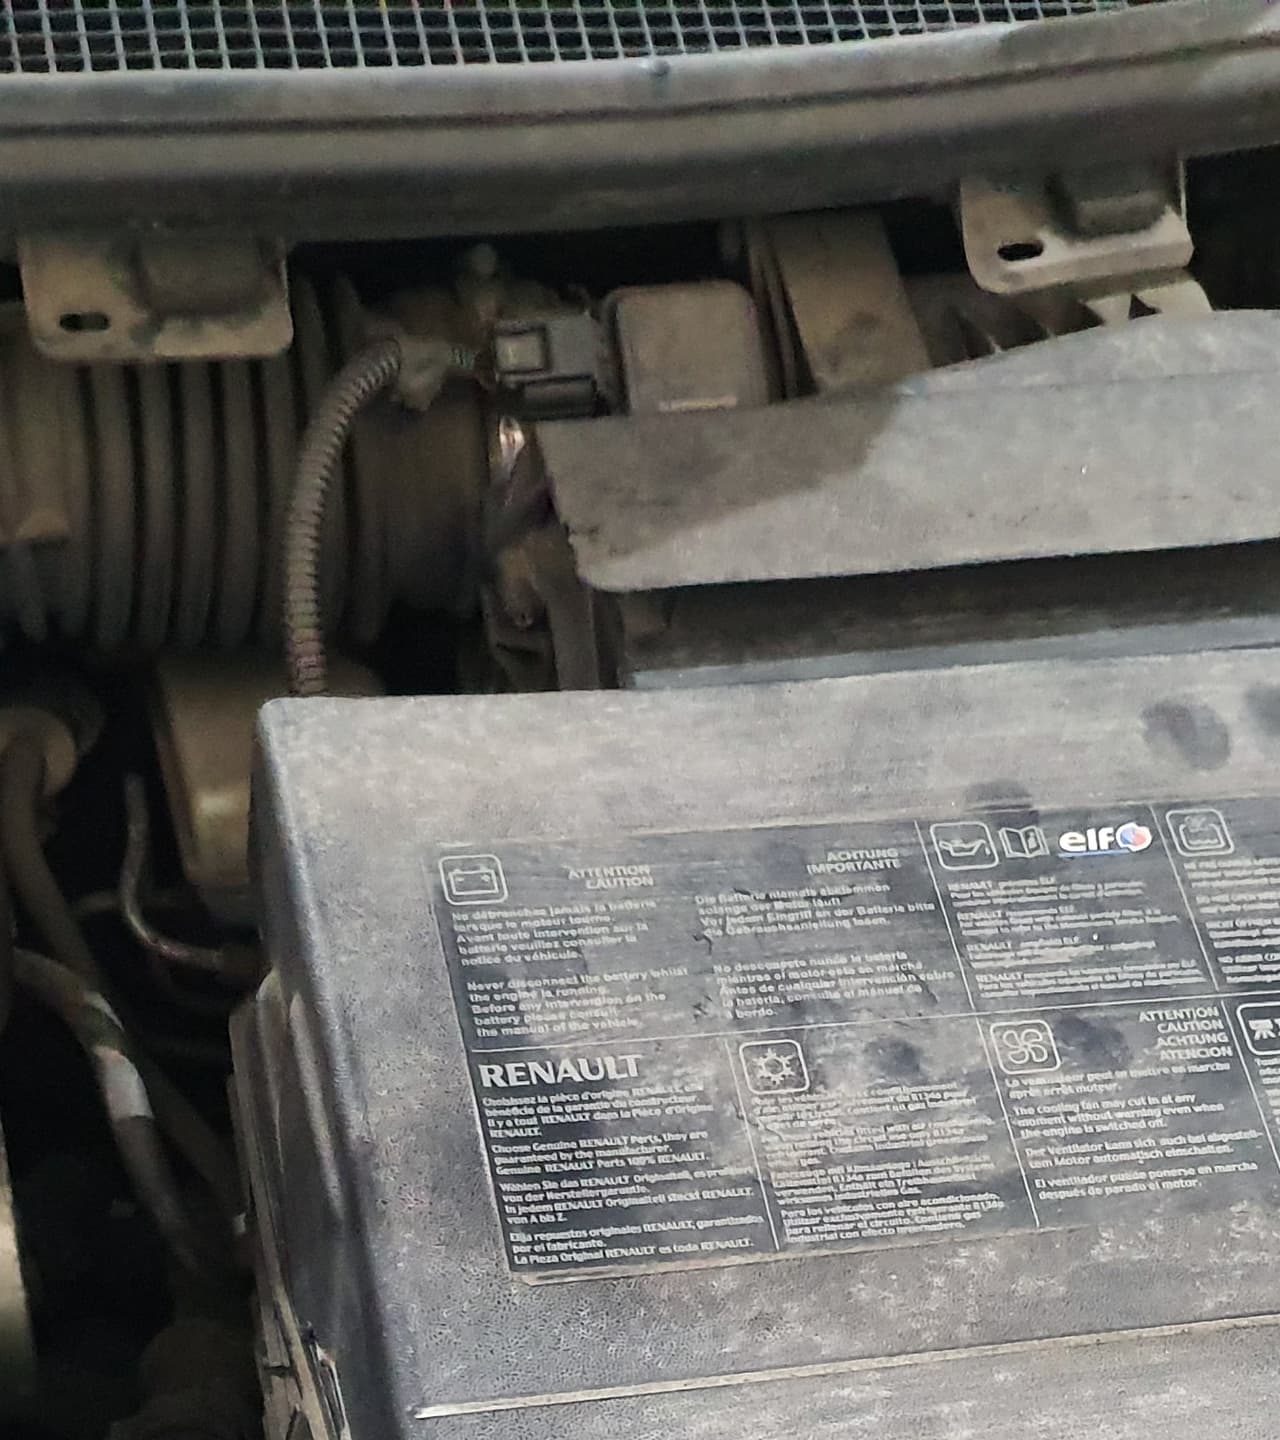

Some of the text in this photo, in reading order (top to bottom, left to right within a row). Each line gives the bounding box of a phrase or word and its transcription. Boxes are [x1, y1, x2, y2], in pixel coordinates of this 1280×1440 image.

[826, 848, 898, 860] ACHTUNG
[807, 860, 901, 873] IMPORTANTE
[586, 877, 653, 888] CAUTION
[1138, 1007, 1219, 1021] ATTENTION
[1157, 1020, 1223, 1032] CAUTION
[1155, 1032, 1228, 1046] ACHTUNG
[479, 1054, 642, 1087] RENAULT
[541, 1113, 590, 1123] RENAULT
[579, 1136, 629, 1148] RENAULT
[545, 1161, 595, 1172] RENAULT
[580, 1174, 628, 1186] RENAULT
[554, 1199, 603, 1212] RENAULT
[605, 1245, 655, 1257] RENAULT
